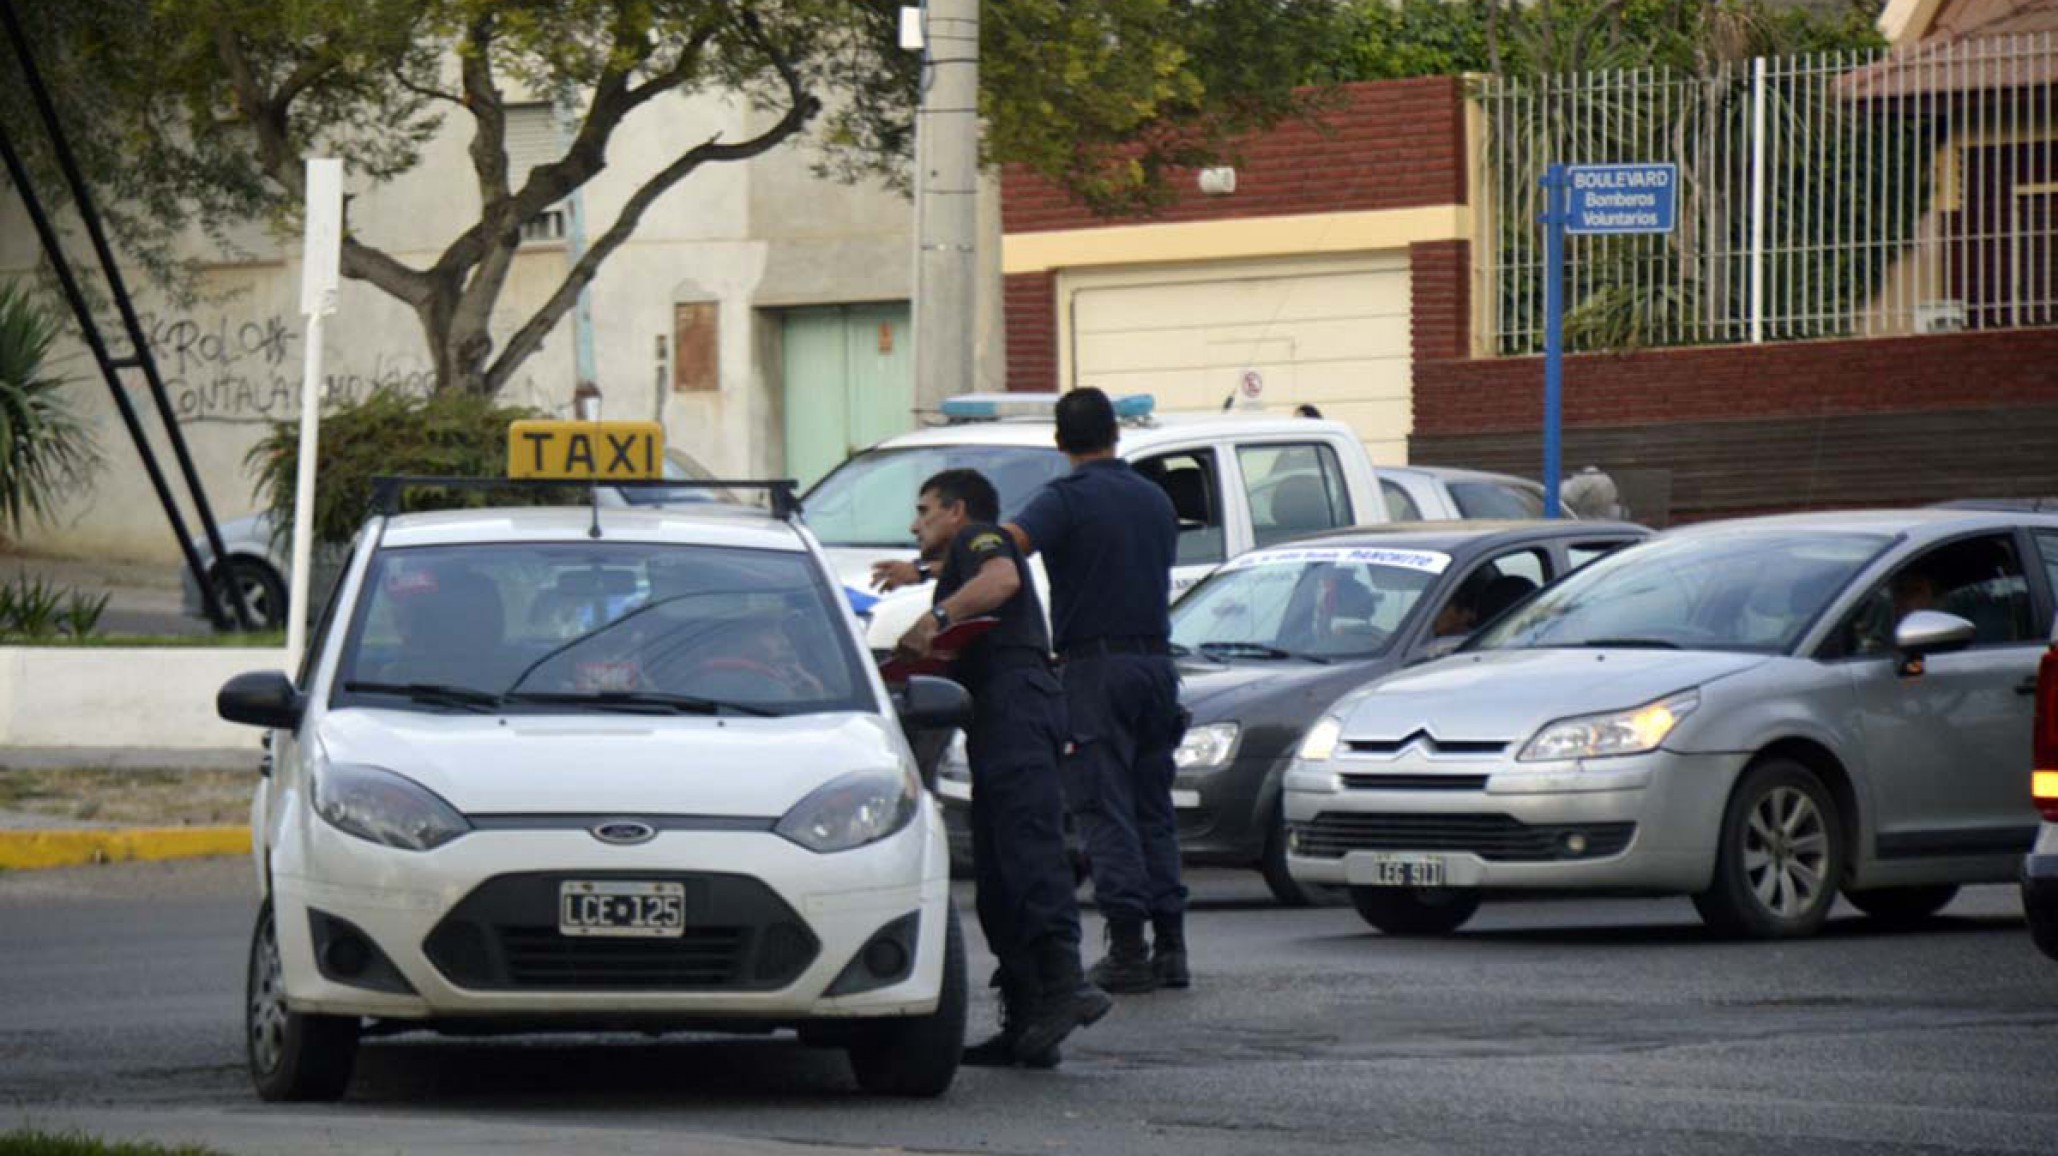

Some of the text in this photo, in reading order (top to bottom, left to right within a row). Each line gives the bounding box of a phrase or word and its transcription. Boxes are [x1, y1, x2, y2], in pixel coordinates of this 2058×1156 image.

[1575, 170, 1668, 188] BOULEVARD
[1585, 192, 1656, 207] Bomberos
[1583, 210, 1658, 226] Voluntarios
[522, 432, 653, 473] TAXI
[565, 895, 682, 927] LCE 125
